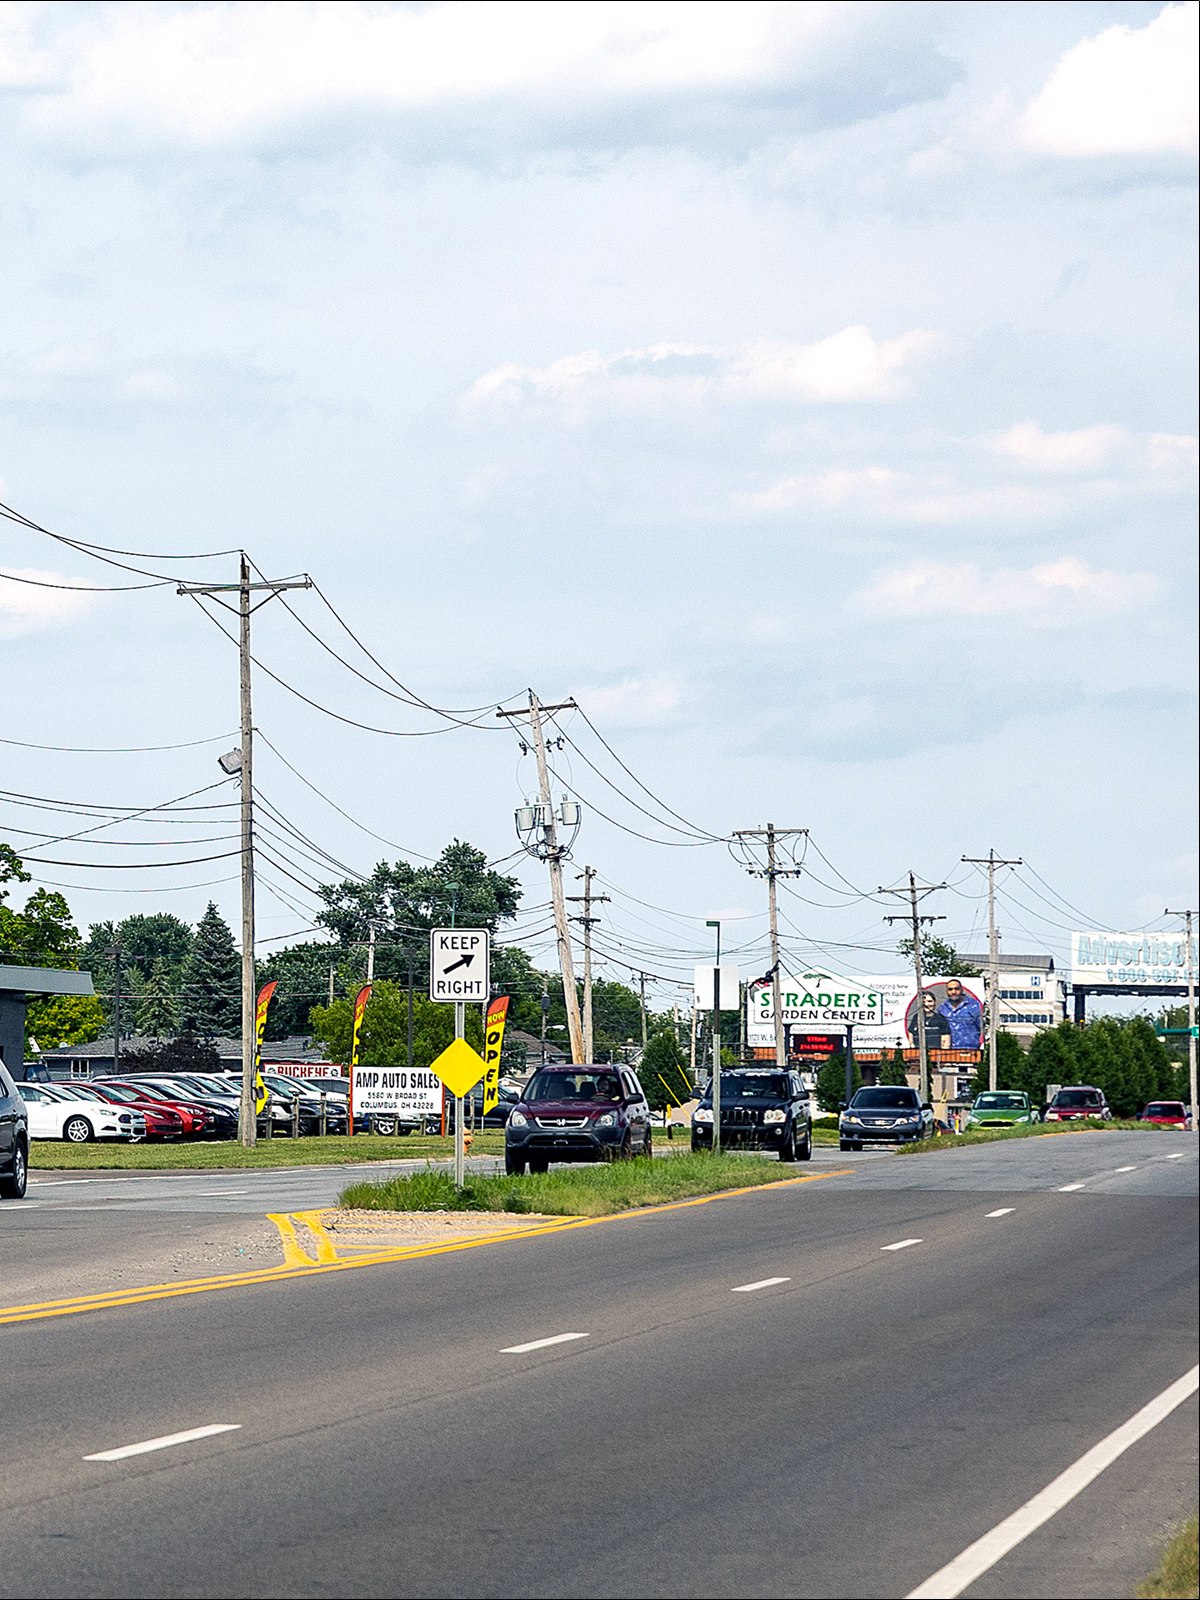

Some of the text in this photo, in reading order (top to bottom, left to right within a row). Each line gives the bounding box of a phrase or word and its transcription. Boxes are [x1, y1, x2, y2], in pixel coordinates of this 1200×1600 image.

[440, 936, 480, 950] KEEP
[1078, 935, 1186, 967] Advertise
[437, 981, 482, 994] RIGHT
[760, 992, 877, 1008] SRADER'S
[487, 1010, 505, 1025] NOW
[822, 1010, 876, 1020] CENTER
[277, 1066, 329, 1077] BUCKEYE
[486, 1031, 500, 1101] OPEN
[355, 1072, 440, 1089] AMP AUTO SALES
[412, 1102, 434, 1110] 43228
